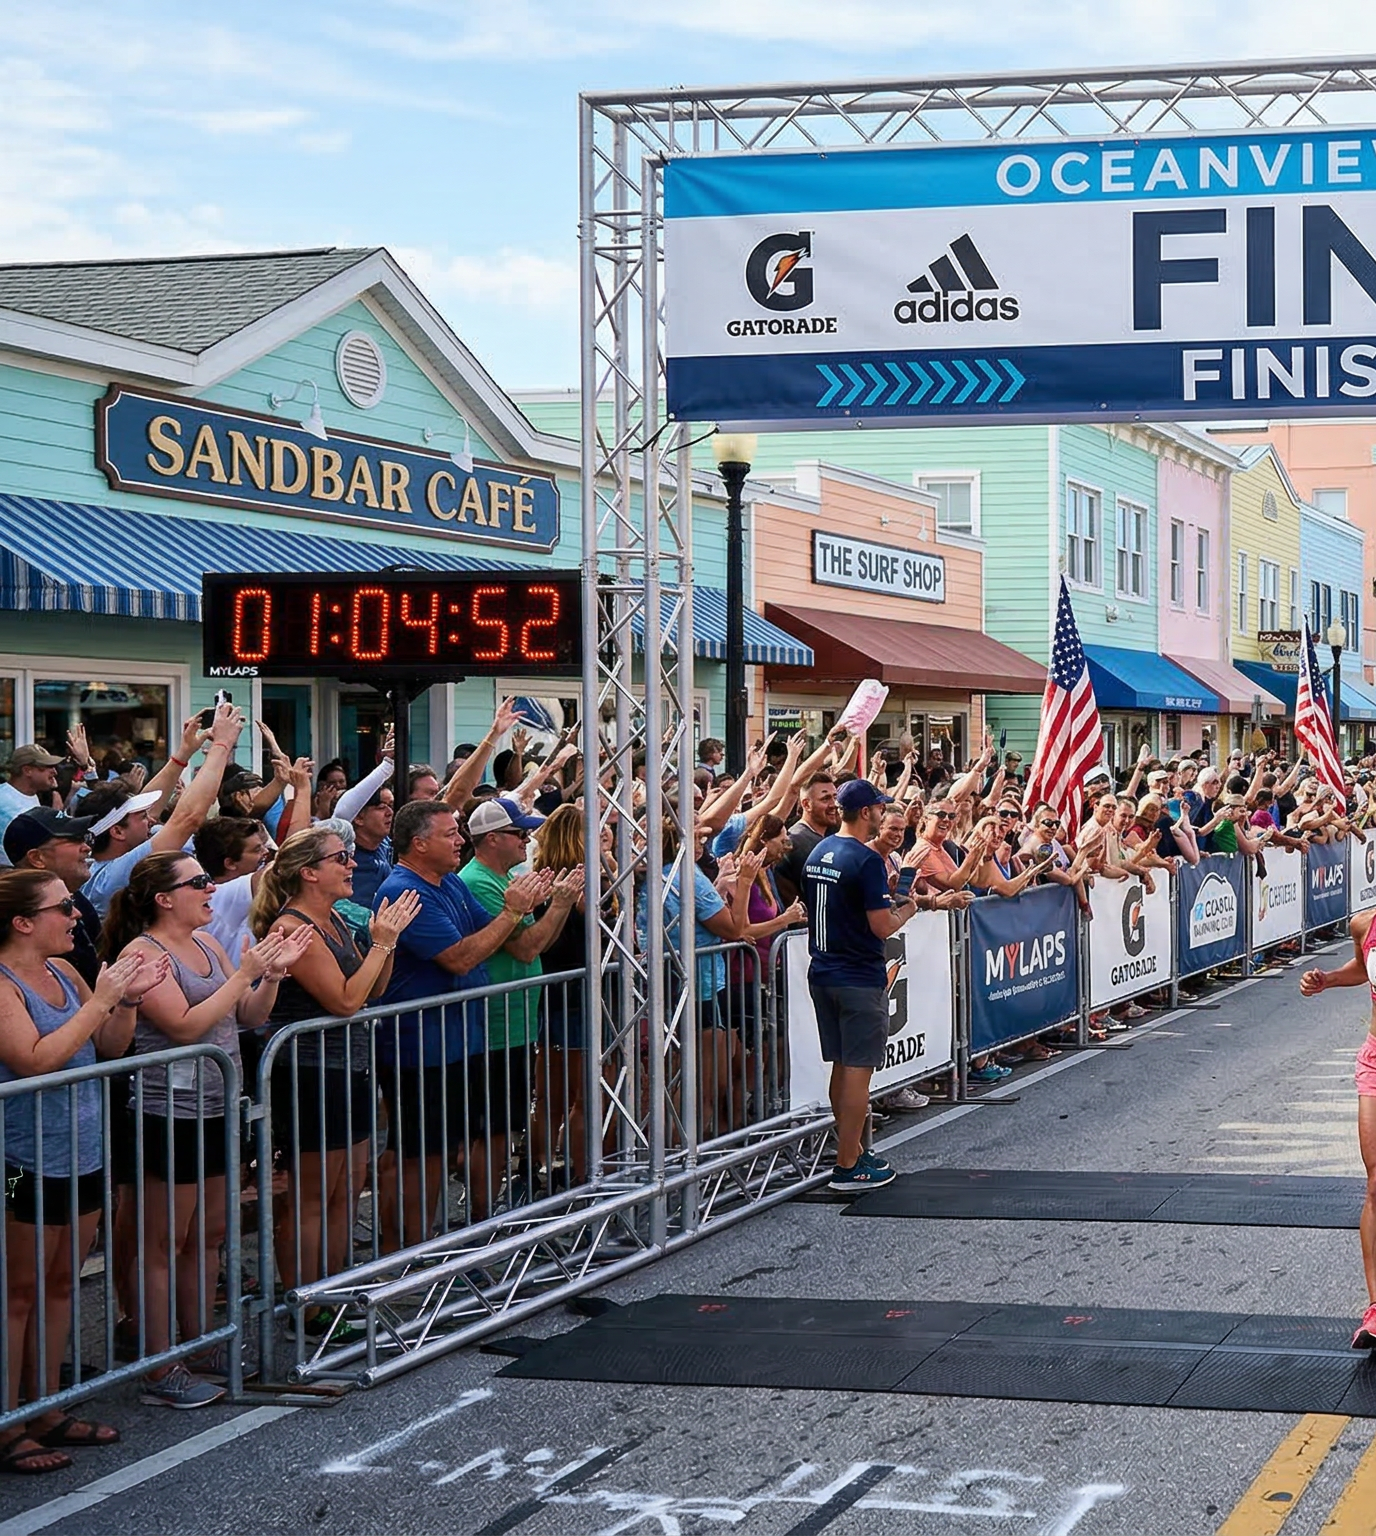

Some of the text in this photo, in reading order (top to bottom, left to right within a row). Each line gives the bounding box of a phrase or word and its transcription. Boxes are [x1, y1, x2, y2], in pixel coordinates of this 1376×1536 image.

[725, 316, 838, 338] GATORADE
[894, 289, 1020, 325] adidas
[146, 415, 537, 534] SANDBAR CAFÉ
[819, 541, 942, 592] THE SURF SHOP
[233, 587, 560, 661] 01:04:52
[209, 666, 259, 676] MYLAPS
[986, 930, 1066, 986] MYLAPS
